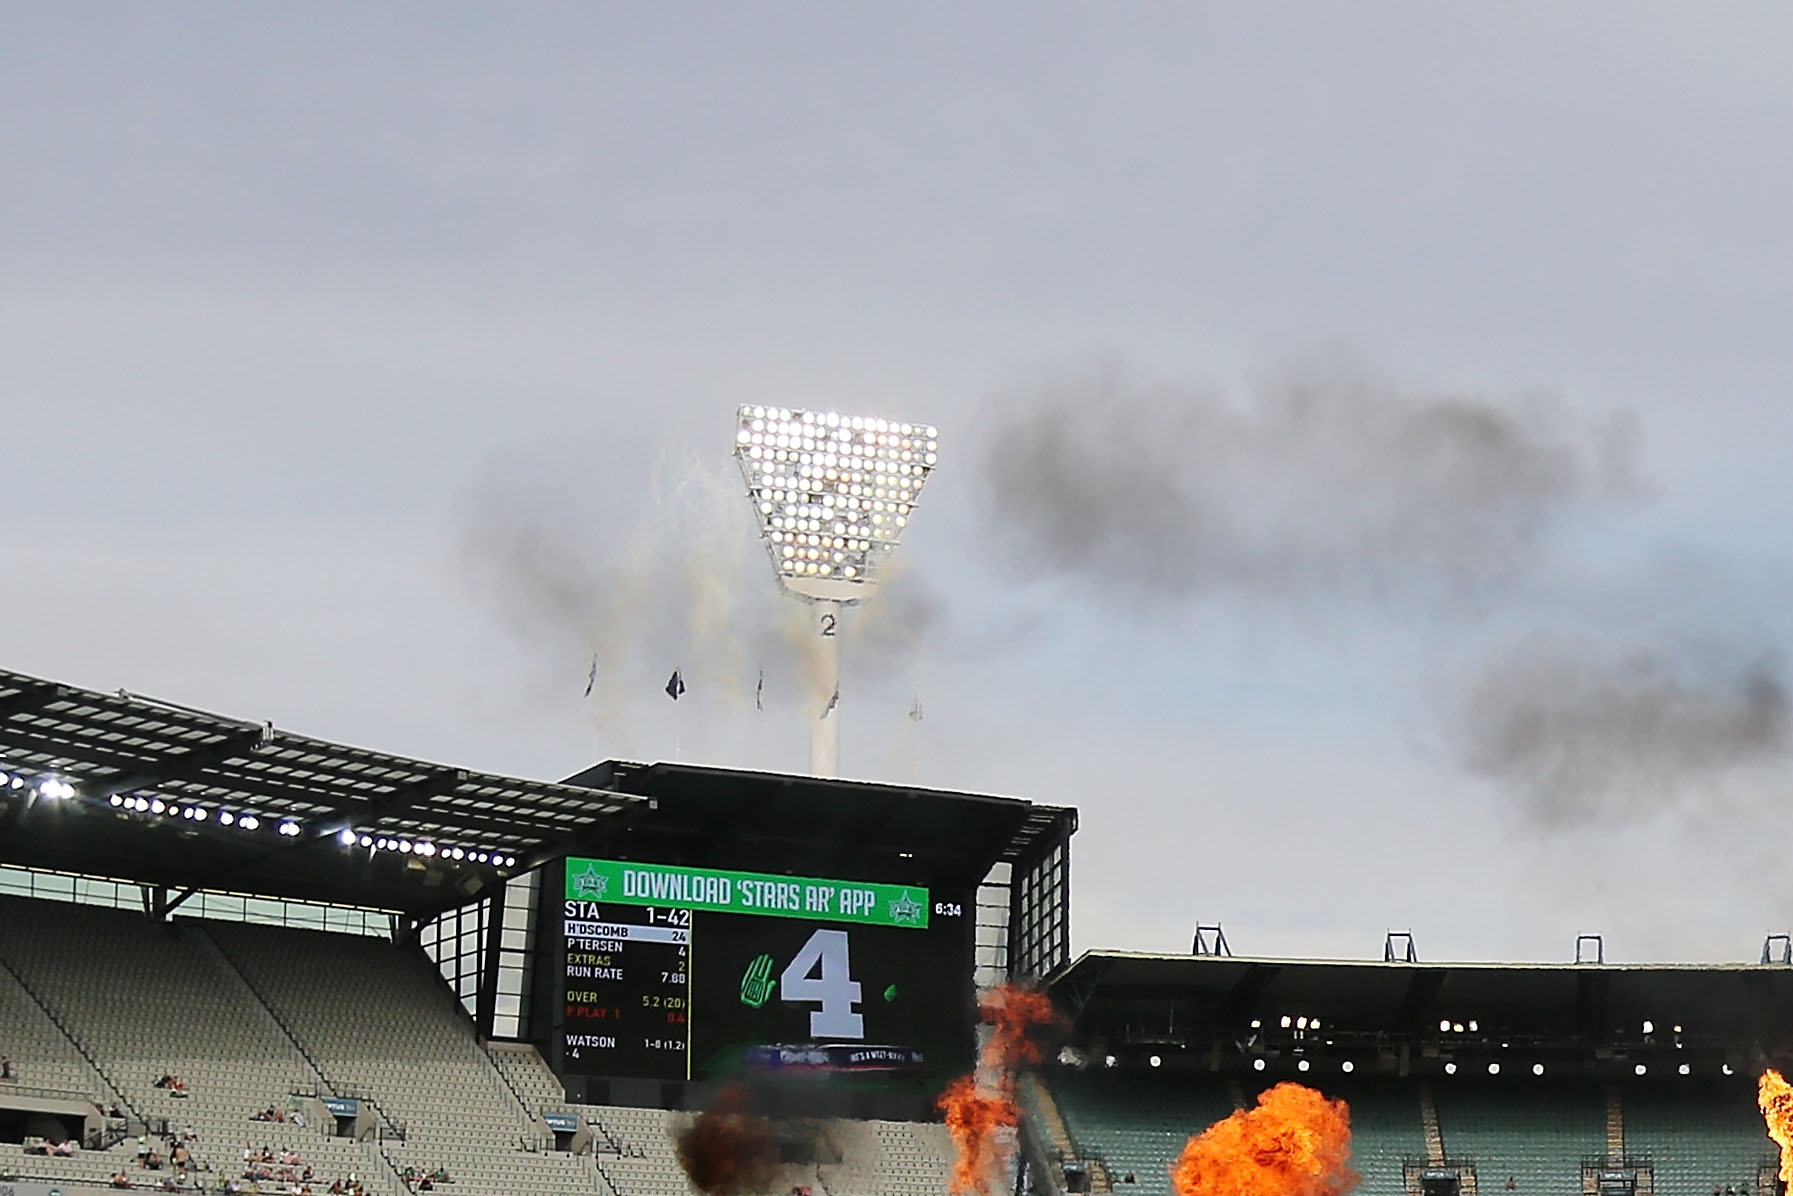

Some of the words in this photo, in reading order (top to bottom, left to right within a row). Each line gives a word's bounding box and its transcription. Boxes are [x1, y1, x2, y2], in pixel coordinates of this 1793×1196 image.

[820, 614, 836, 636] 2
[622, 869, 731, 905] DOWNLOAD
[839, 889, 876, 917] APP
[564, 900, 600, 919] STA
[646, 906, 690, 926] 1-42
[935, 902, 962, 918] 6:34
[567, 923, 629, 938] H'DSCOMB
[672, 931, 686, 942] 24
[567, 938, 623, 952] P'TERSEN
[678, 946, 686, 957] 4
[566, 953, 611, 966] EXTRAS
[678, 961, 686, 972] 2
[566, 965, 591, 978] RUN
[594, 967, 624, 980] RATE
[780, 928, 865, 1039] 4
[566, 991, 598, 1003] OVER
[643, 995, 660, 1008] 5.2
[663, 997, 686, 1009] (20)
[566, 1035, 616, 1048] WATSON
